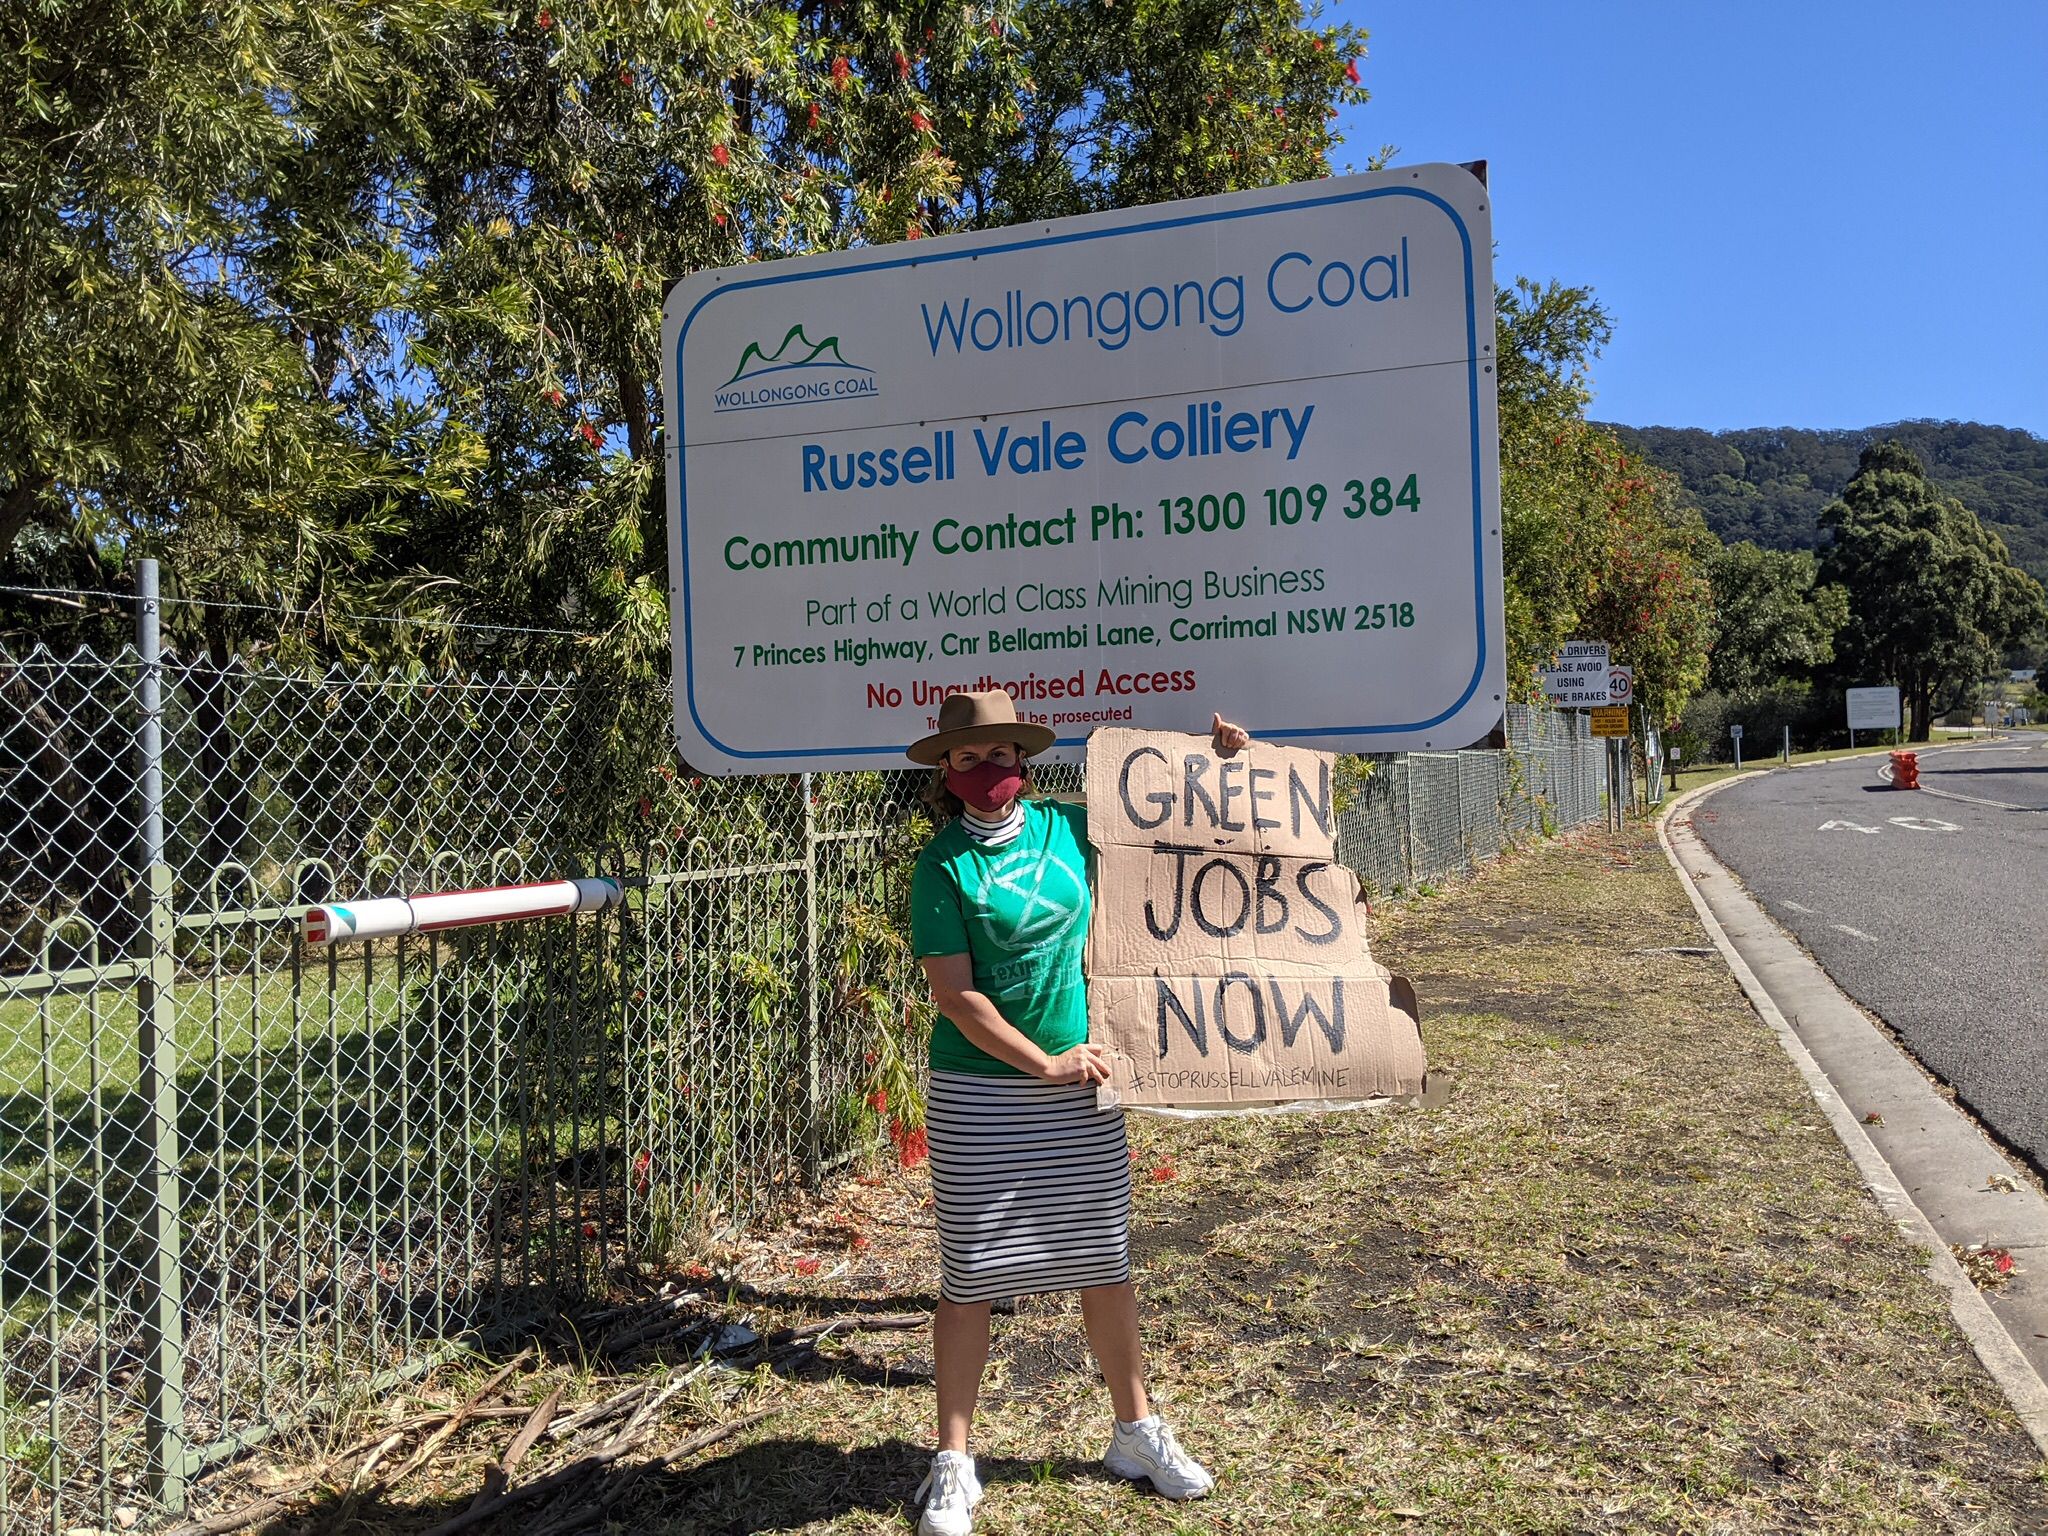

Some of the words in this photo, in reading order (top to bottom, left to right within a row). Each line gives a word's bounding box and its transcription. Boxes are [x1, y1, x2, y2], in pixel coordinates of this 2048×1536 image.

[920, 275, 1245, 358] Wollongong
[1266, 236, 1410, 314] Coal
[714, 380, 831, 408] WOLLONGONG
[834, 376, 878, 396] COAL
[802, 430, 955, 493] Russell
[973, 420, 1087, 477] Vale
[1107, 400, 1316, 464] Colliery
[723, 523, 920, 571] Community
[932, 507, 1077, 555] Contact
[1091, 502, 1144, 542] Ph:
[1158, 491, 1246, 535] 1300
[1263, 483, 1328, 526] 109
[1343, 473, 1421, 520] 384
[806, 596, 858, 627] Part
[866, 593, 892, 623] of
[900, 598, 919, 621] a
[927, 585, 1006, 618] World
[1015, 582, 1087, 613] Class
[1097, 574, 1193, 609] Mining
[1203, 565, 1326, 600] Business
[733, 645, 746, 668] 7
[753, 643, 826, 667] Princes
[834, 637, 934, 667] Highway,
[940, 632, 981, 657] Cnr
[988, 623, 1088, 654] Bellambi
[1096, 623, 1162, 647] Lane,
[1169, 611, 1277, 643] Corrimal
[1287, 606, 1347, 635] NSW
[1354, 601, 1416, 631] 2518
[1567, 645, 1606, 656] DRIVERS
[1539, 662, 1574, 673] PLEASE
[1576, 662, 1602, 672] AVOID
[1557, 677, 1585, 688] USING
[1609, 678, 1628, 692] 40
[866, 682, 903, 709] No
[1094, 668, 1197, 696] Access
[1547, 692, 1569, 702] GINE
[1571, 691, 1607, 702] BRAKES
[1029, 711, 1048, 725] be
[1052, 705, 1133, 727] prosecuted
[1118, 746, 1333, 838] GREEN
[1144, 840, 1343, 945] JOBS
[1153, 967, 1346, 1060] NOW
[1128, 1066, 1350, 1094] #STOPRUSSELLVALEMINE
